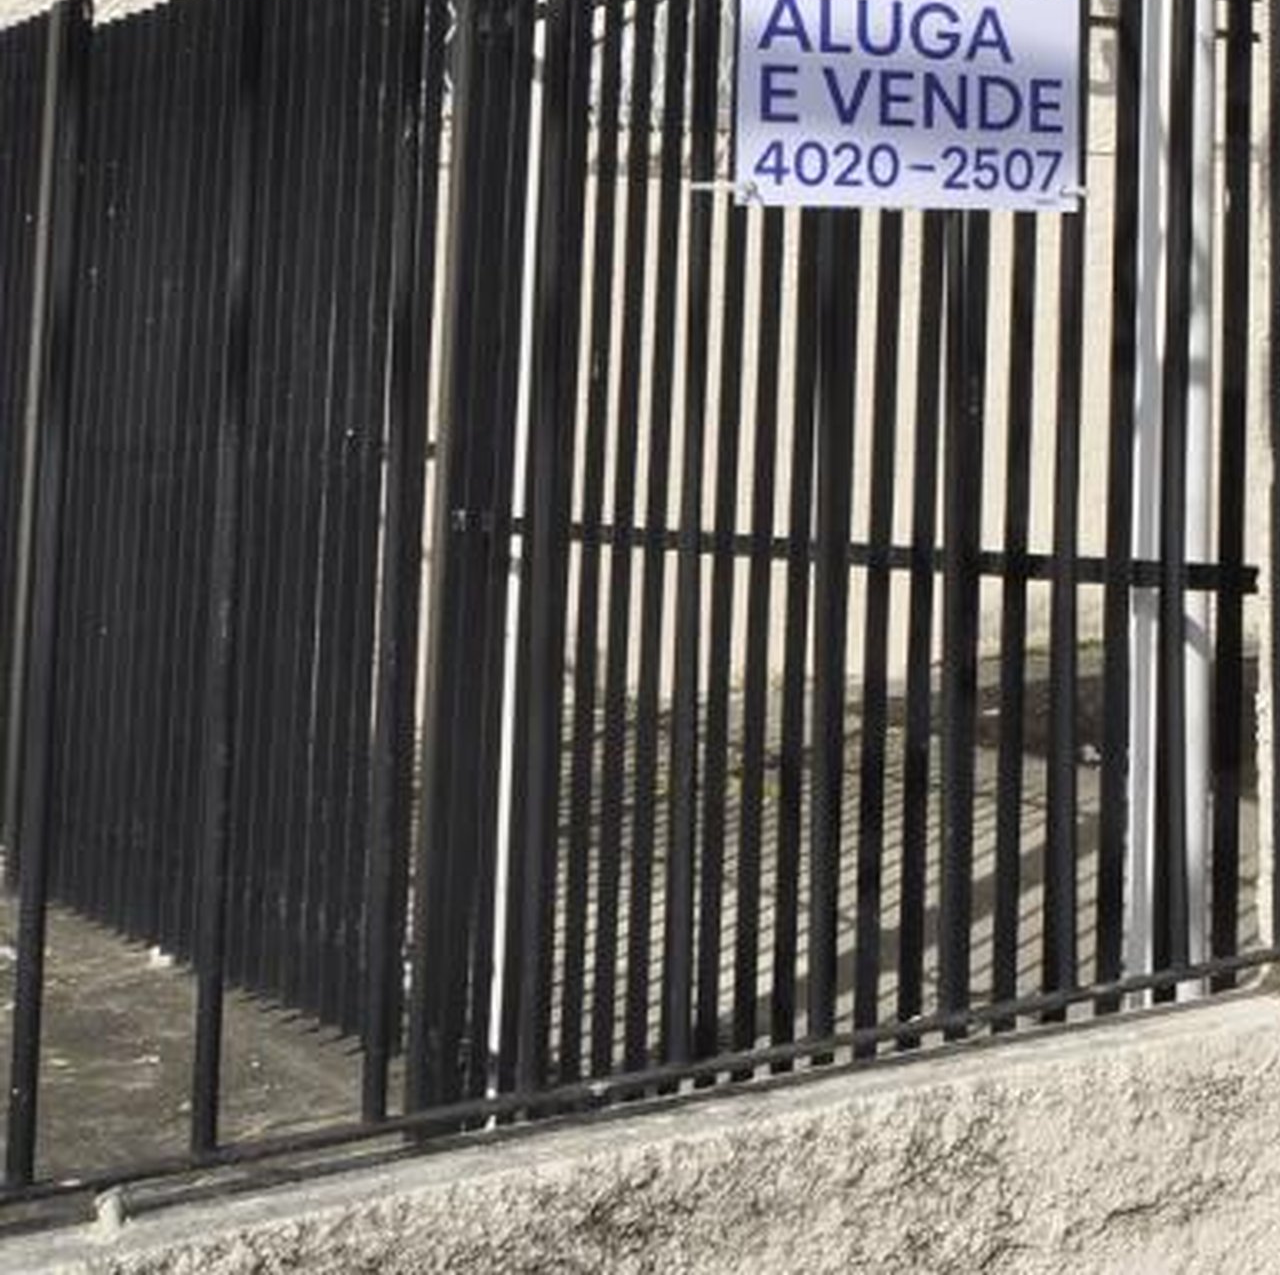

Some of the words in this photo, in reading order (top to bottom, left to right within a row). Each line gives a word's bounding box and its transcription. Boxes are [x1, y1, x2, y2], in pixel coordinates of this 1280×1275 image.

[760, 65, 799, 123] E
[822, 67, 1063, 133] VENDE
[754, 140, 1063, 192] 4020-2507
